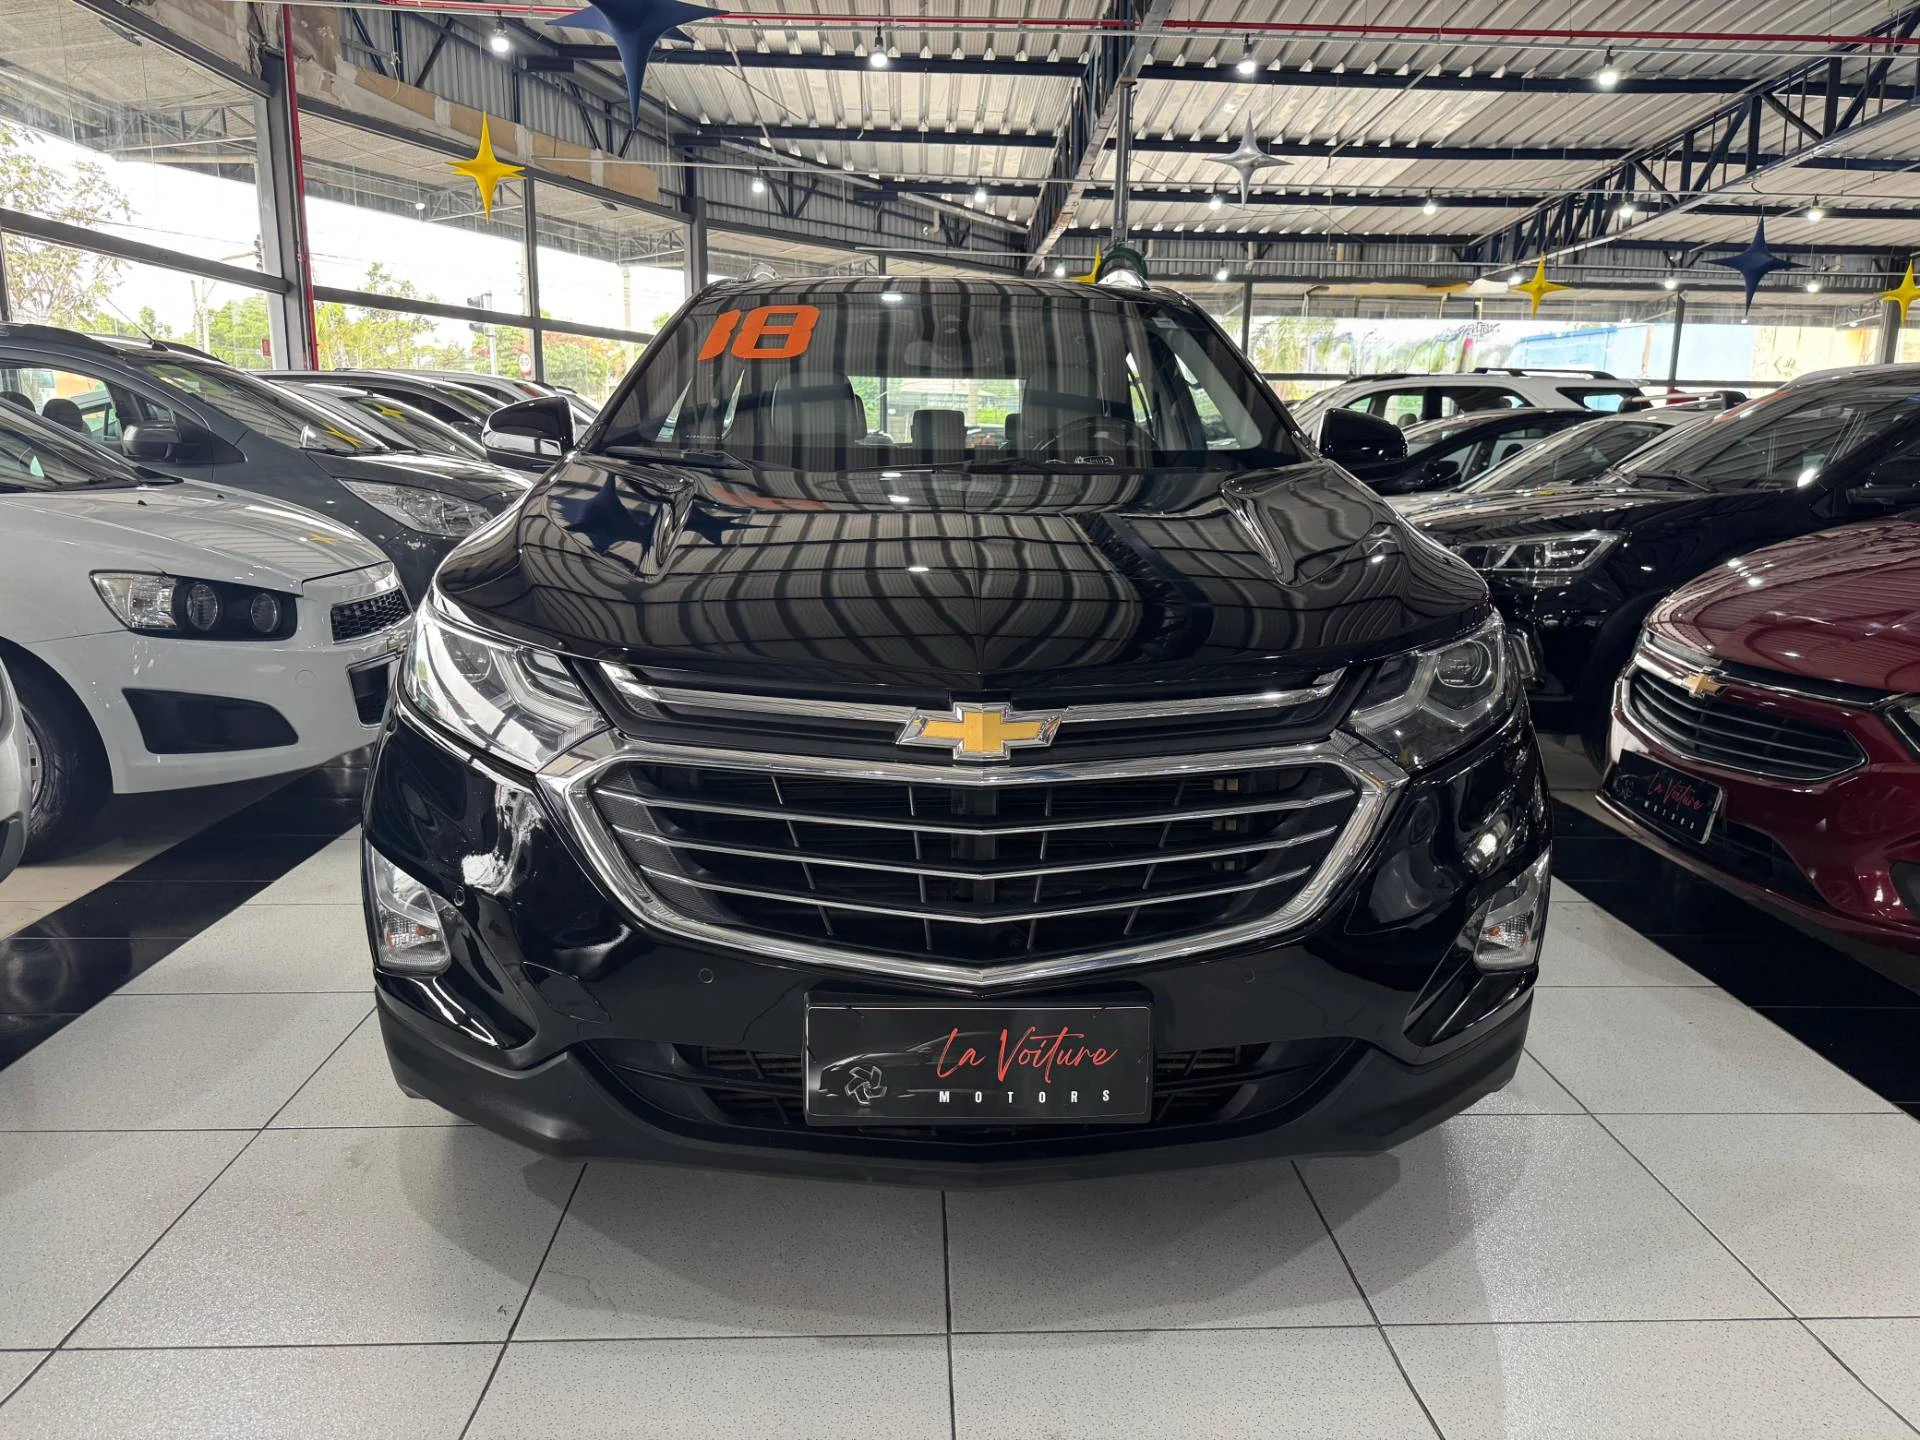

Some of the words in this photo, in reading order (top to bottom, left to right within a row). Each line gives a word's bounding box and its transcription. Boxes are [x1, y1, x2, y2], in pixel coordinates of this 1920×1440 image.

[697, 304, 821, 361] 18
[936, 1027, 986, 1079] La
[996, 1026, 1119, 1083] Voiture
[938, 1089, 1110, 1104] MOTORS
